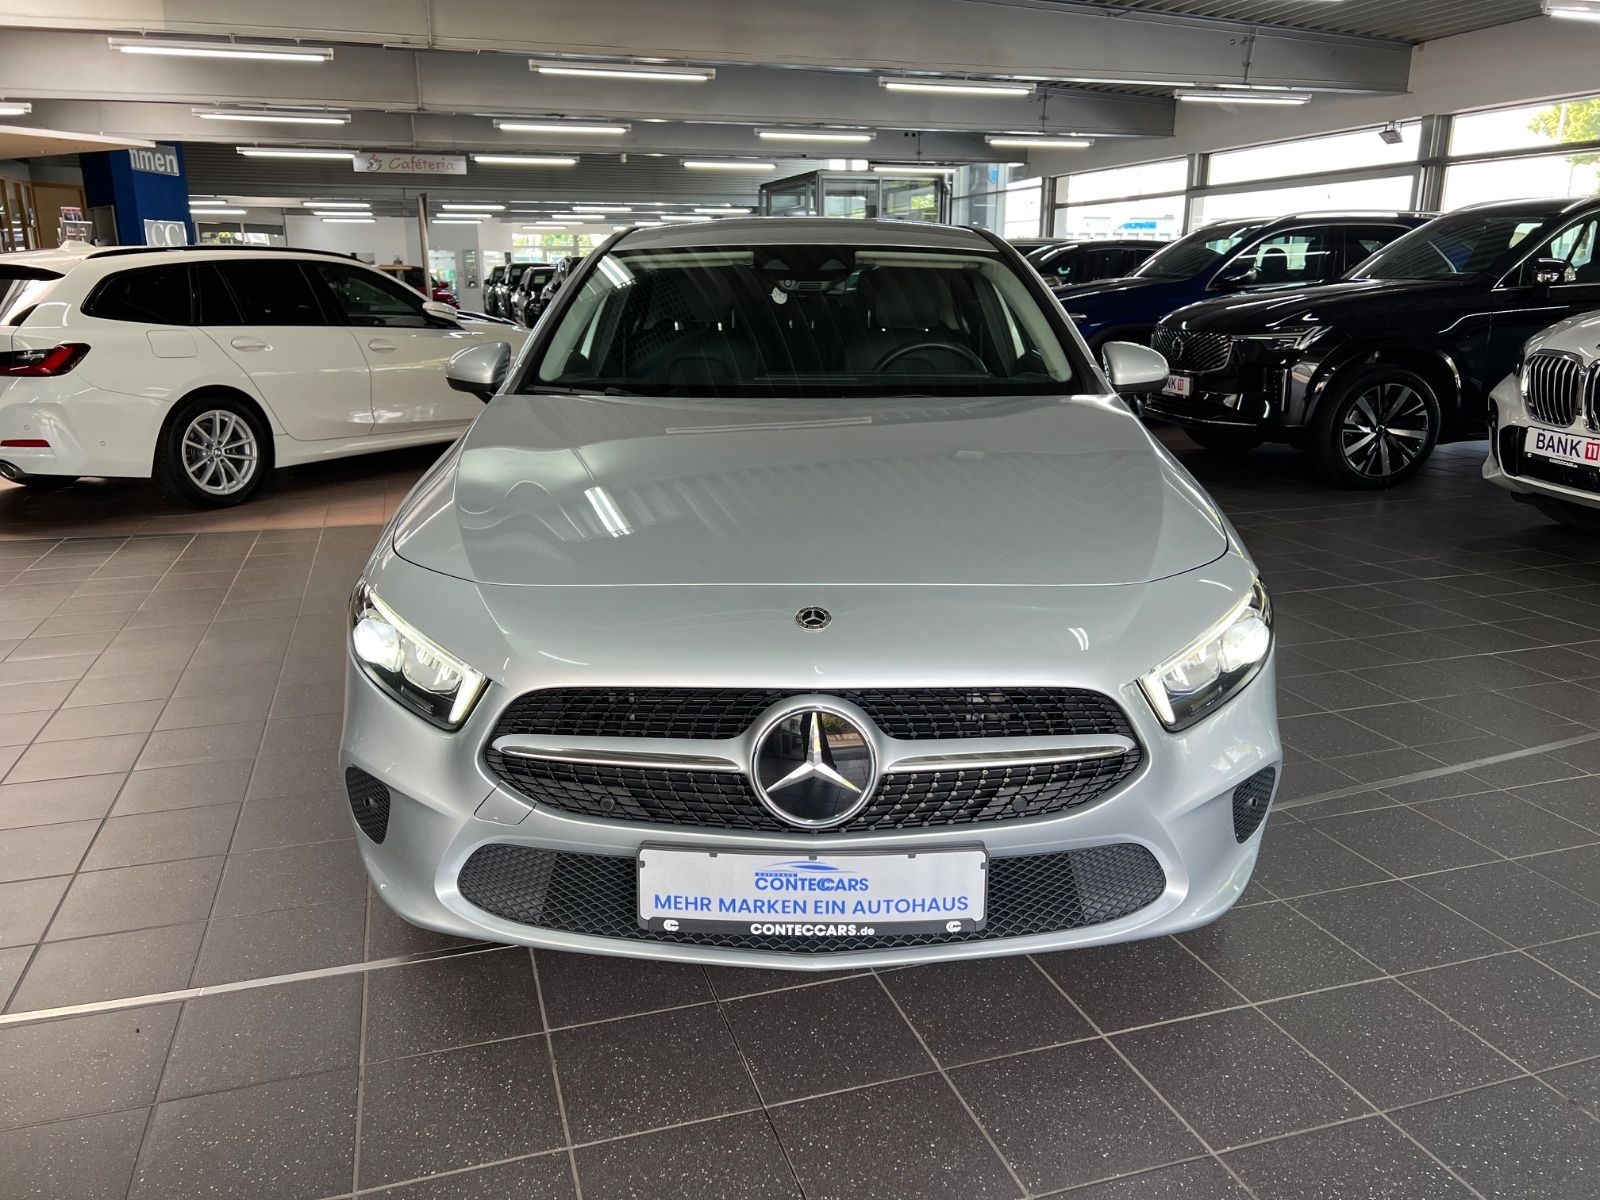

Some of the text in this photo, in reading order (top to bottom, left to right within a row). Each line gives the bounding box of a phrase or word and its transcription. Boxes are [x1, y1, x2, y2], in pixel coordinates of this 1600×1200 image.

[1536, 433, 1600, 460] BANK 11
[654, 894, 969, 915] MEHR MARKEN EIN AUTOHAUS
[750, 923, 875, 937] CONTECCARS.de
